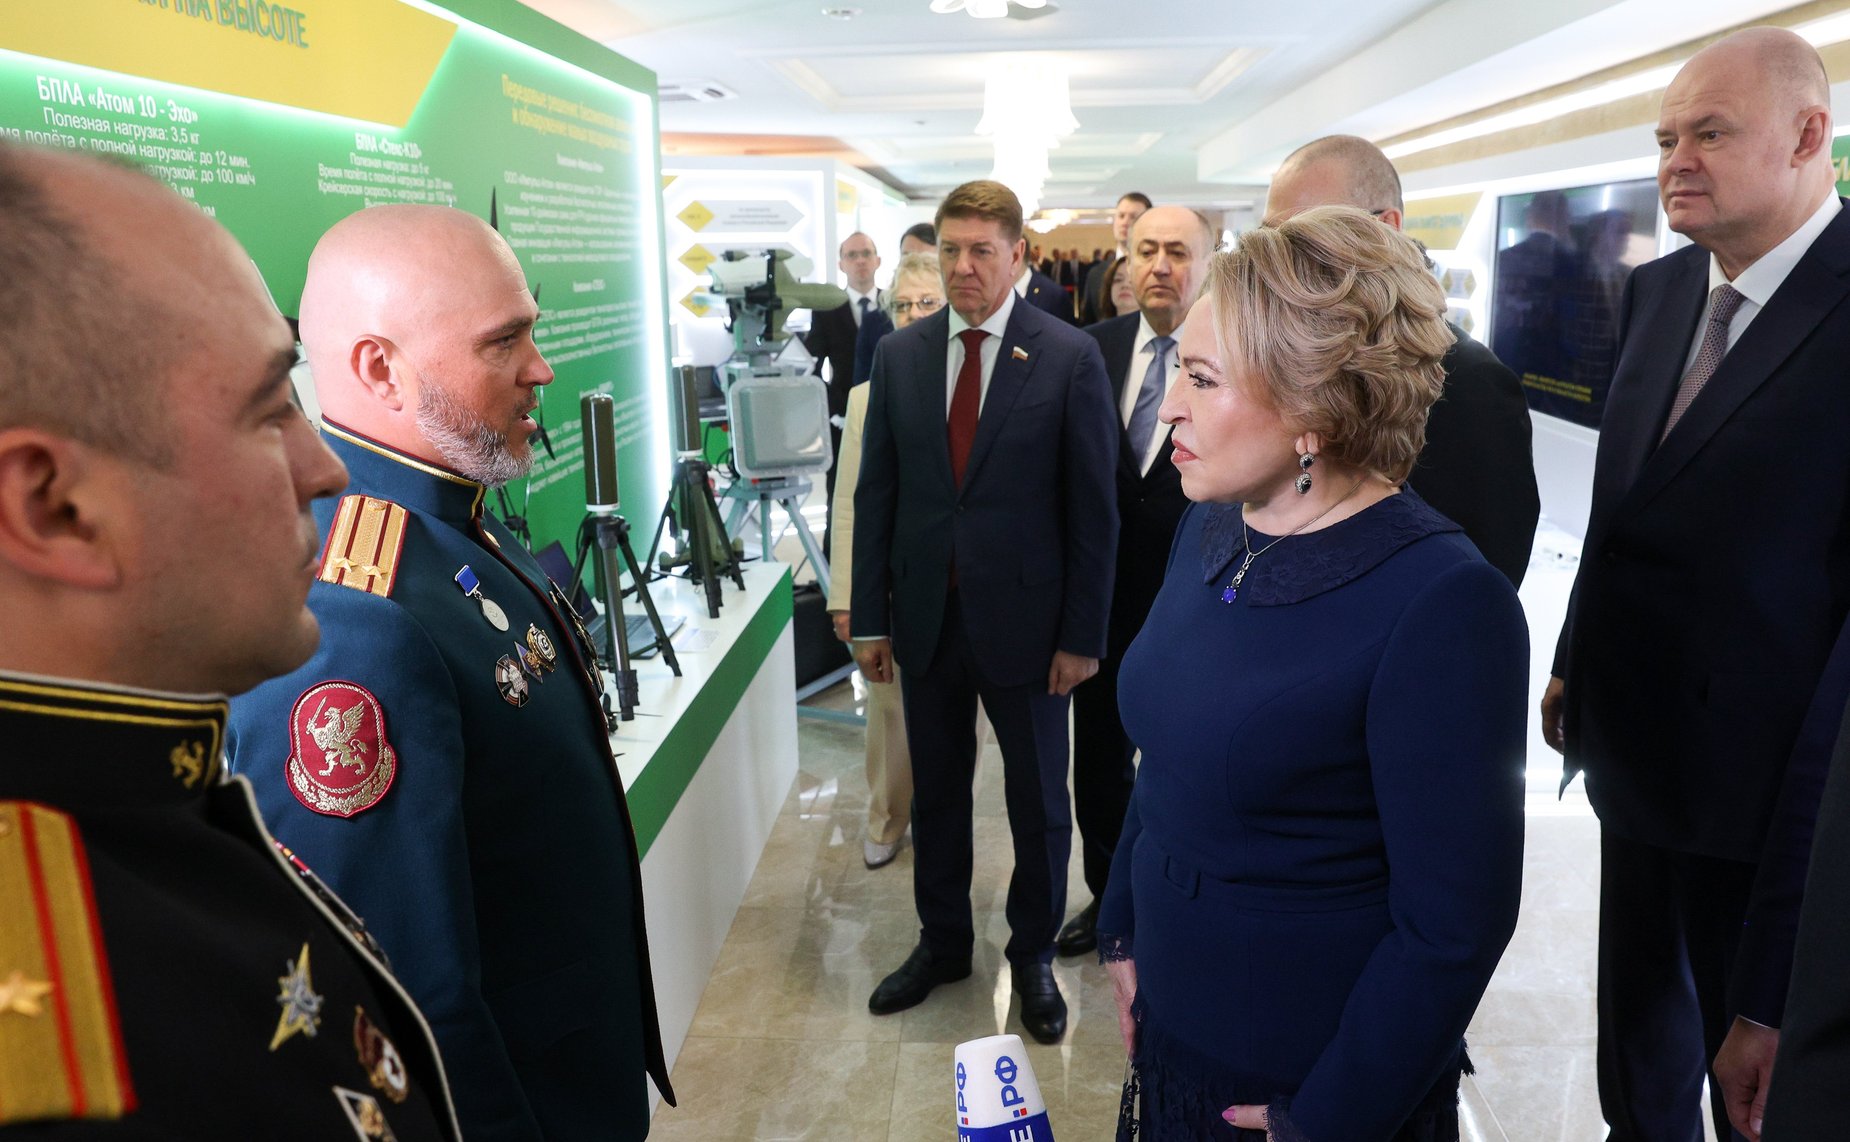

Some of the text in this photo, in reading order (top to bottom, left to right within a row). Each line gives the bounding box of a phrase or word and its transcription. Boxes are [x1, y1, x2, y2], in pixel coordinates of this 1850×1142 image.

[214, 0, 309, 48] ВЫСОТЕ
[36, 75, 86, 107] БПЛА
[88, 86, 135, 115] «Атом
[138, 94, 157, 118] 10
[167, 98, 199, 124] Эхо»
[43, 106, 111, 133] Полезная
[113, 121, 169, 142] нагрузка:
[170, 126, 189, 145] 3,5
[25, 128, 76, 149] полёта
[91, 138, 137, 156] полной
[139, 144, 198, 164] нагрузкой:
[200, 152, 213, 166] до
[215, 150, 228, 166] 12
[201, 170, 215, 184] до
[216, 168, 234, 184] 100
